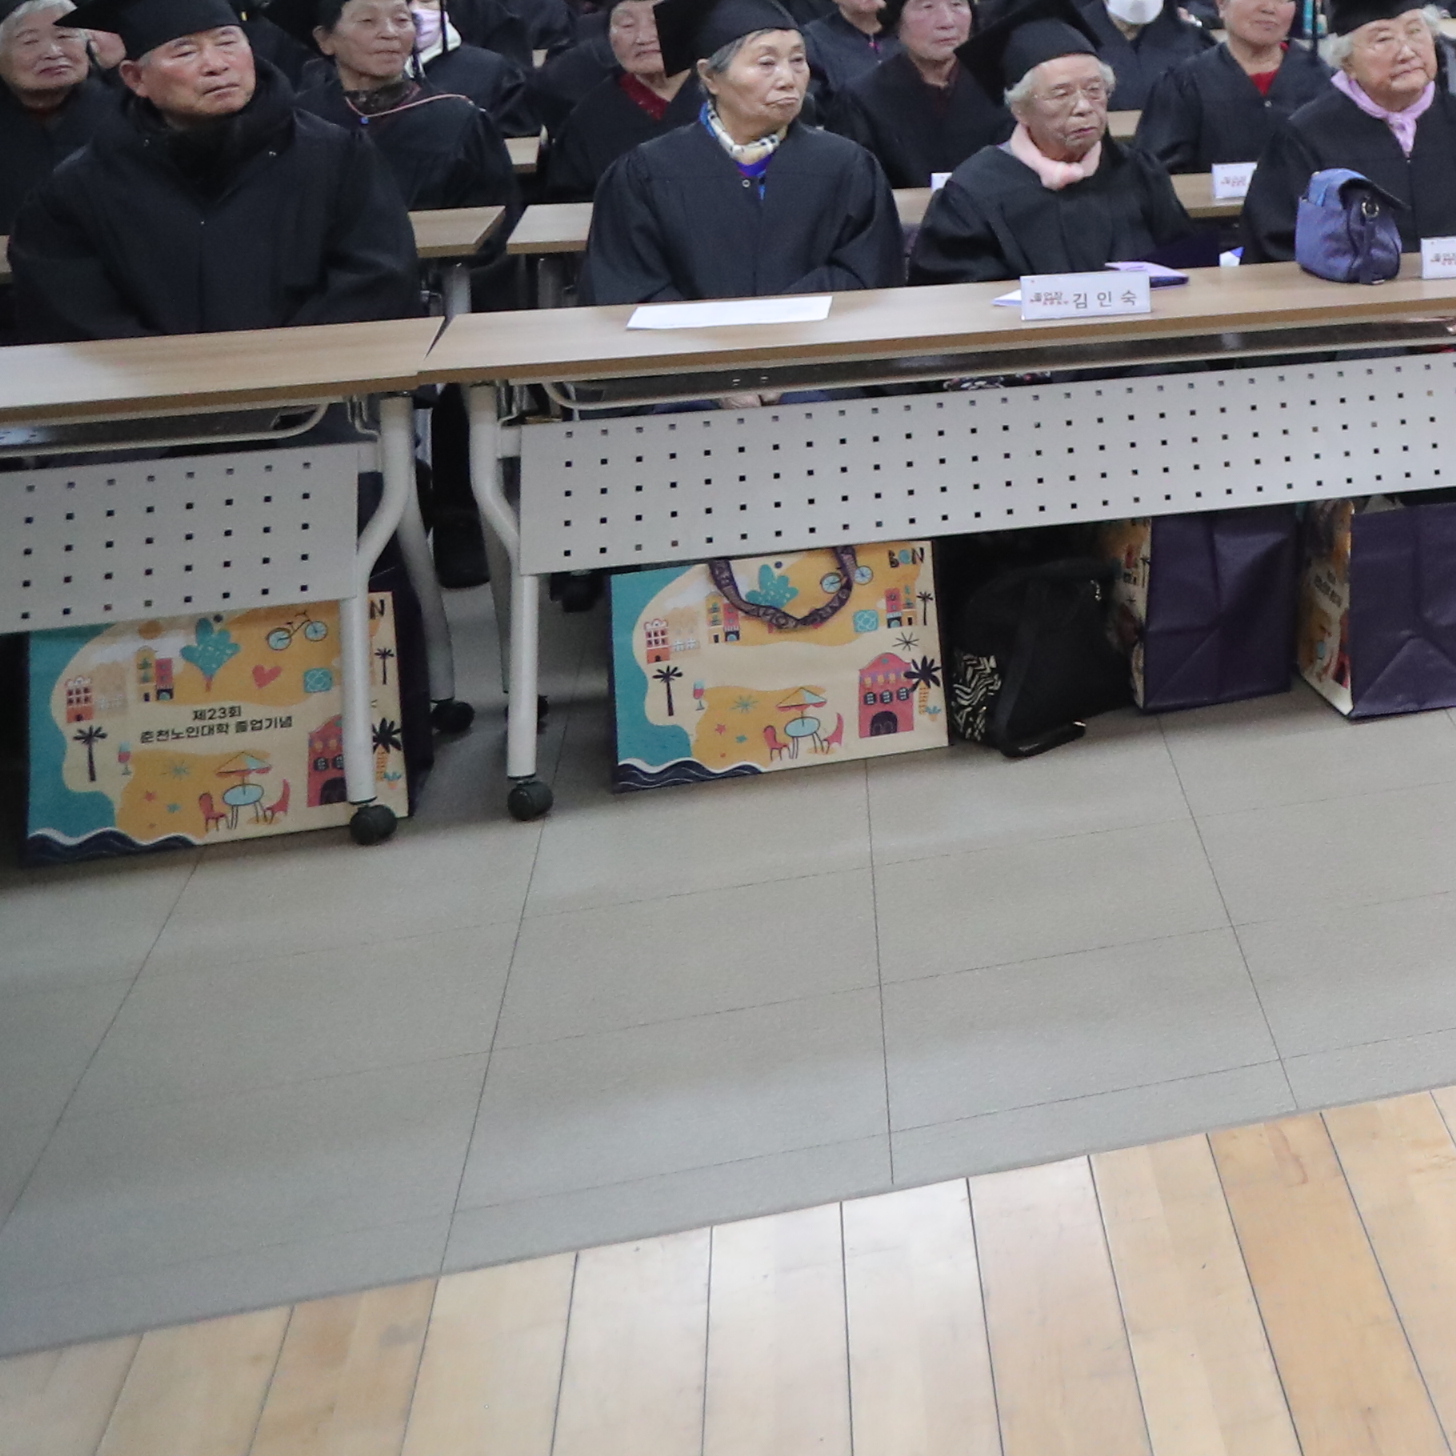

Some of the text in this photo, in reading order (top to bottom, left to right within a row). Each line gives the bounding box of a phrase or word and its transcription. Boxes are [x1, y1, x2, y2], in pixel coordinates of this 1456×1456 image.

[1072, 289, 1137, 309] 김인숙
[888, 546, 925, 568] BON
[192, 705, 242, 721] 제23회
[140, 715, 293, 744] 춘천노인대학 졸업기념
